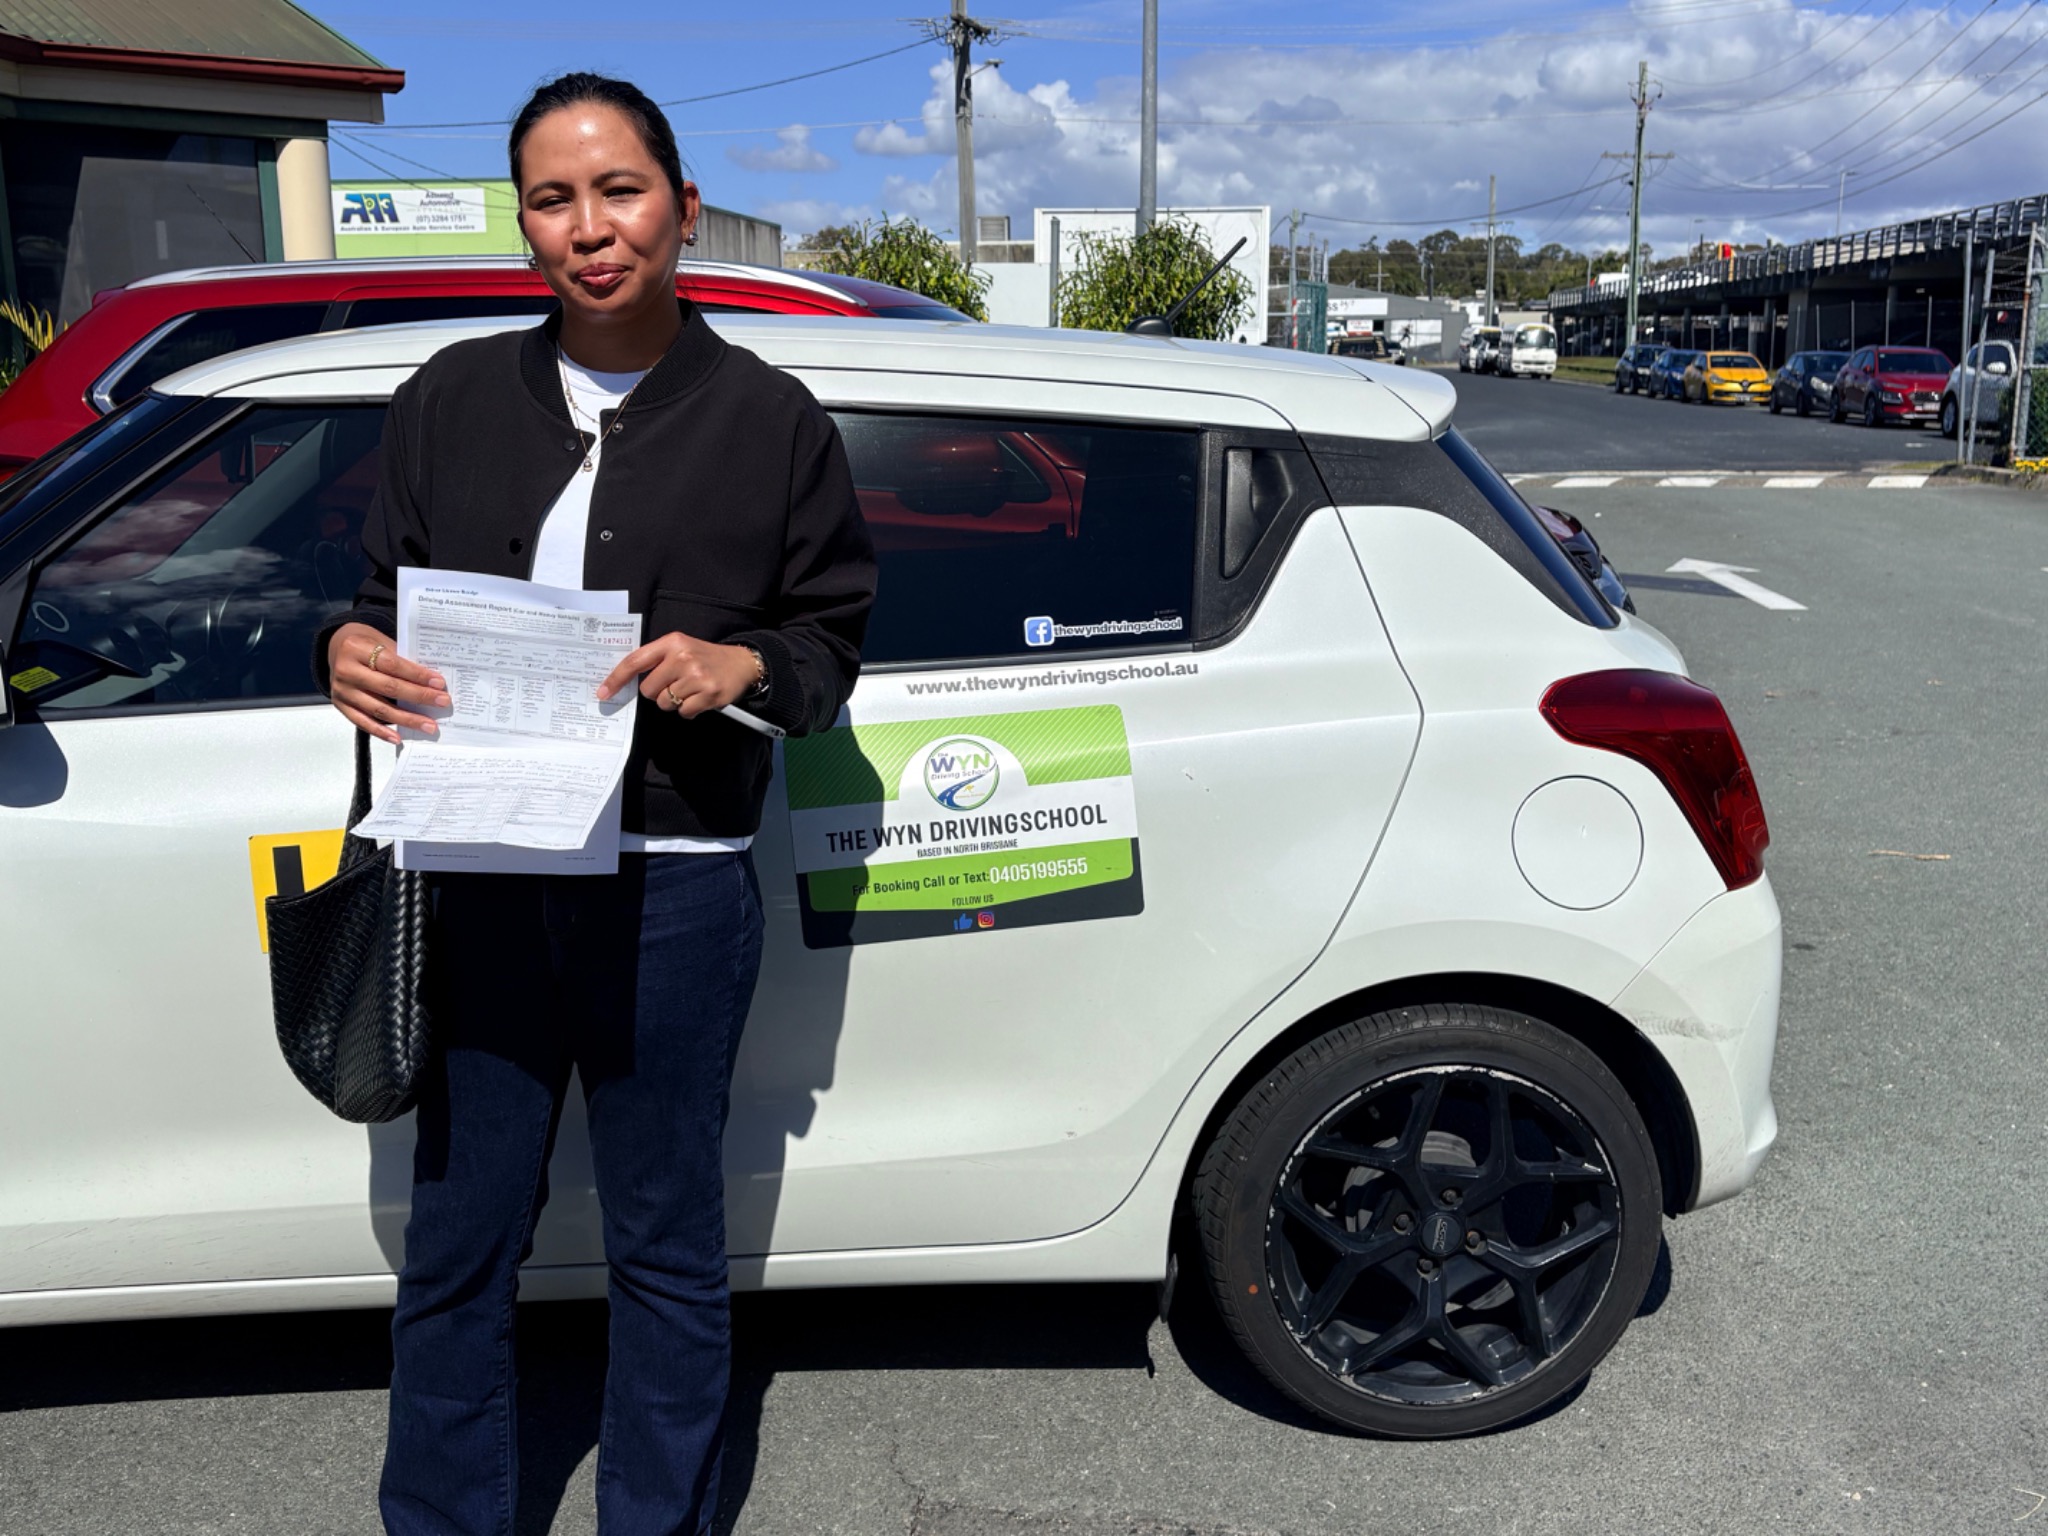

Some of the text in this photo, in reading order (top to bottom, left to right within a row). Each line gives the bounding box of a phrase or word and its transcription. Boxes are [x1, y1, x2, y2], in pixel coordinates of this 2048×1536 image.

[1053, 617, 1183, 638] thewyndrivingschool
[906, 661, 1199, 695] www.thewyndrivingschool.au
[930, 752, 991, 773] WYN
[930, 771, 961, 781] Driving
[826, 804, 1108, 853] THE WYN DRIVINGSCHOOL
[917, 839, 1019, 858] BASED IN NORTH BRISBANE
[852, 883, 871, 896] For
[874, 877, 920, 894] Booking
[923, 873, 945, 889] Call
[949, 876, 960, 886] or
[989, 857, 1088, 884] 0405199555
[951, 893, 994, 907] FOLLOW US
